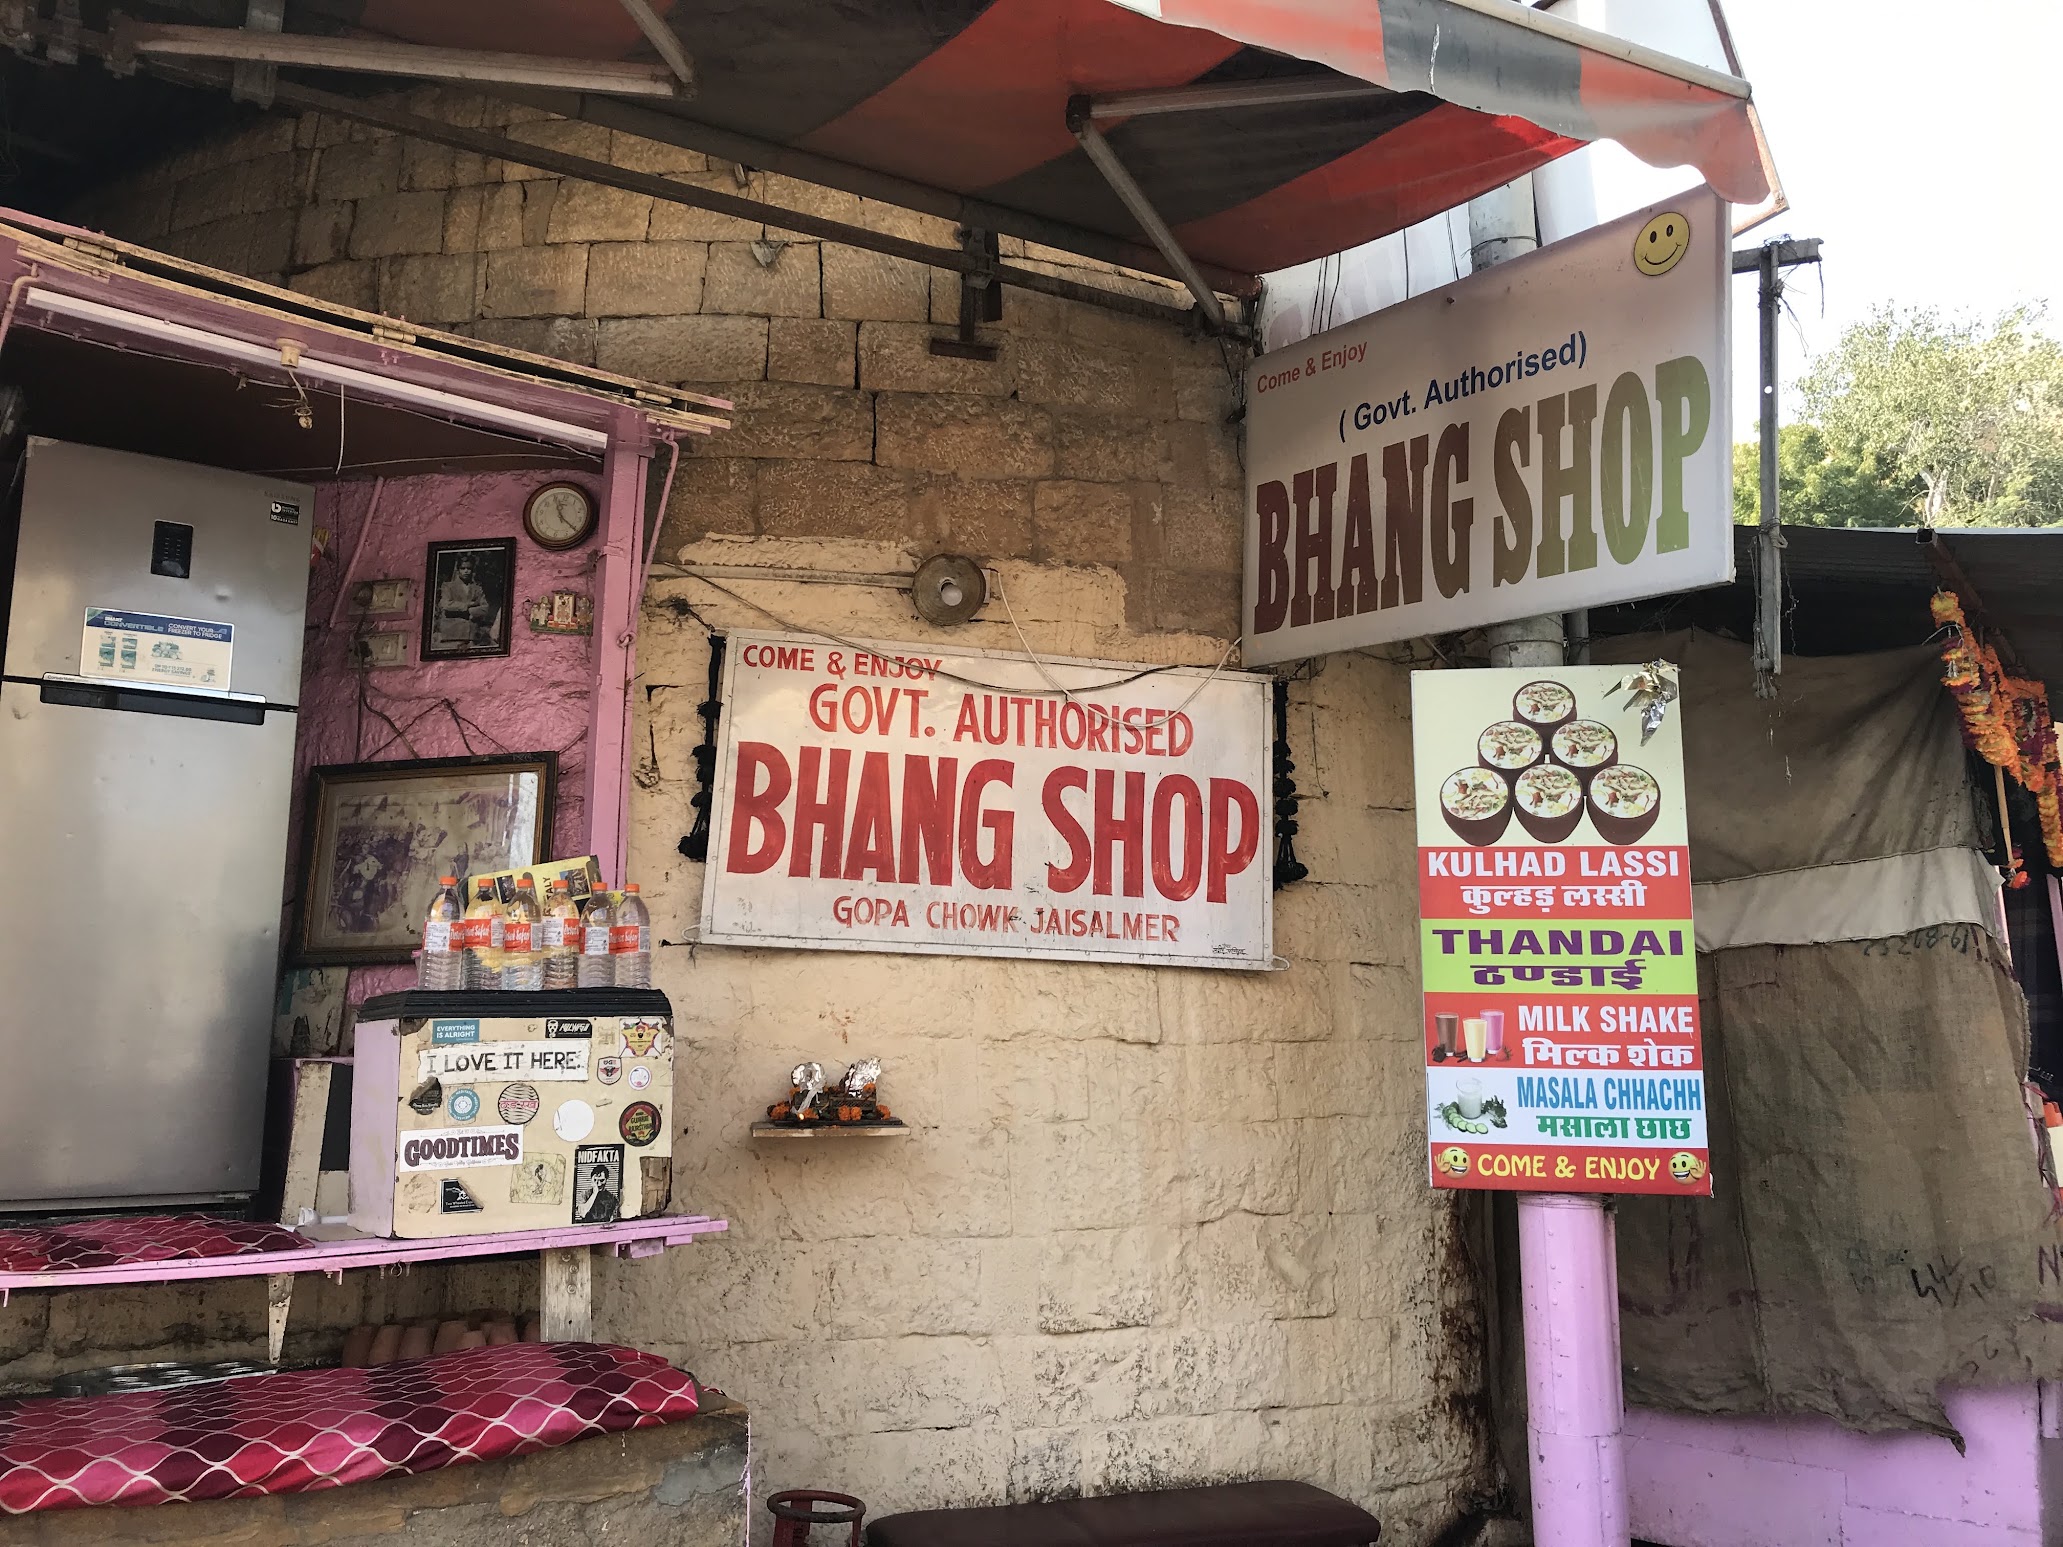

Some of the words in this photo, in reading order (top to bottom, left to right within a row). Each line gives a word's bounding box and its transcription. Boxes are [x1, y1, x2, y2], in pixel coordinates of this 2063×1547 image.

[1257, 365, 1300, 395] Come
[1305, 357, 1317, 376] &
[1321, 339, 1368, 370] Enjoy
[1353, 397, 1418, 432] Govt.
[1424, 330, 1588, 411] Authorised)
[1253, 421, 1474, 635] BHANG
[1493, 355, 1711, 588] SHOP
[167, 628, 193, 636] FREEZER
[202, 631, 222, 639] FRIDGE
[168, 623, 197, 632] CONVERT
[743, 644, 815, 671] COME
[826, 651, 848, 675] &
[854, 653, 942, 682] ENJOY
[809, 683, 936, 738] GOVT.
[953, 694, 1194, 757] AUTHORISED
[727, 741, 1015, 890] BHANG
[1041, 765, 1260, 904] SHOP
[1428, 851, 1566, 877] KULHAD
[1580, 850, 1680, 877] LASSI
[1460, 885, 1556, 915] कुल्हड़
[1561, 879, 1647, 907] लस्सी
[833, 895, 910, 928] GOPA
[926, 901, 1019, 933] CHOWK
[1030, 907, 1180, 942] JAISALMER
[1432, 930, 1684, 956] THANDAI
[1518, 1005, 1591, 1032] MILK
[1600, 1006, 1694, 1033] SHAKE
[427, 1055, 437, 1073] I
[444, 1053, 498, 1072] LOVE
[503, 1052, 524, 1070] IT
[1522, 1037, 1621, 1066] मिल्क
[1627, 1038, 1694, 1067] शेक
[1517, 1076, 1598, 1110] MASALA
[1603, 1077, 1701, 1111] CHHACHH
[1536, 1115, 1630, 1139] मसाला
[1634, 1118, 1692, 1140] छाछ
[404, 1133, 519, 1167] GOODTIMES
[1477, 1153, 1547, 1178] COME
[1554, 1155, 1576, 1178] &
[1585, 1155, 1660, 1180] ENJOY
